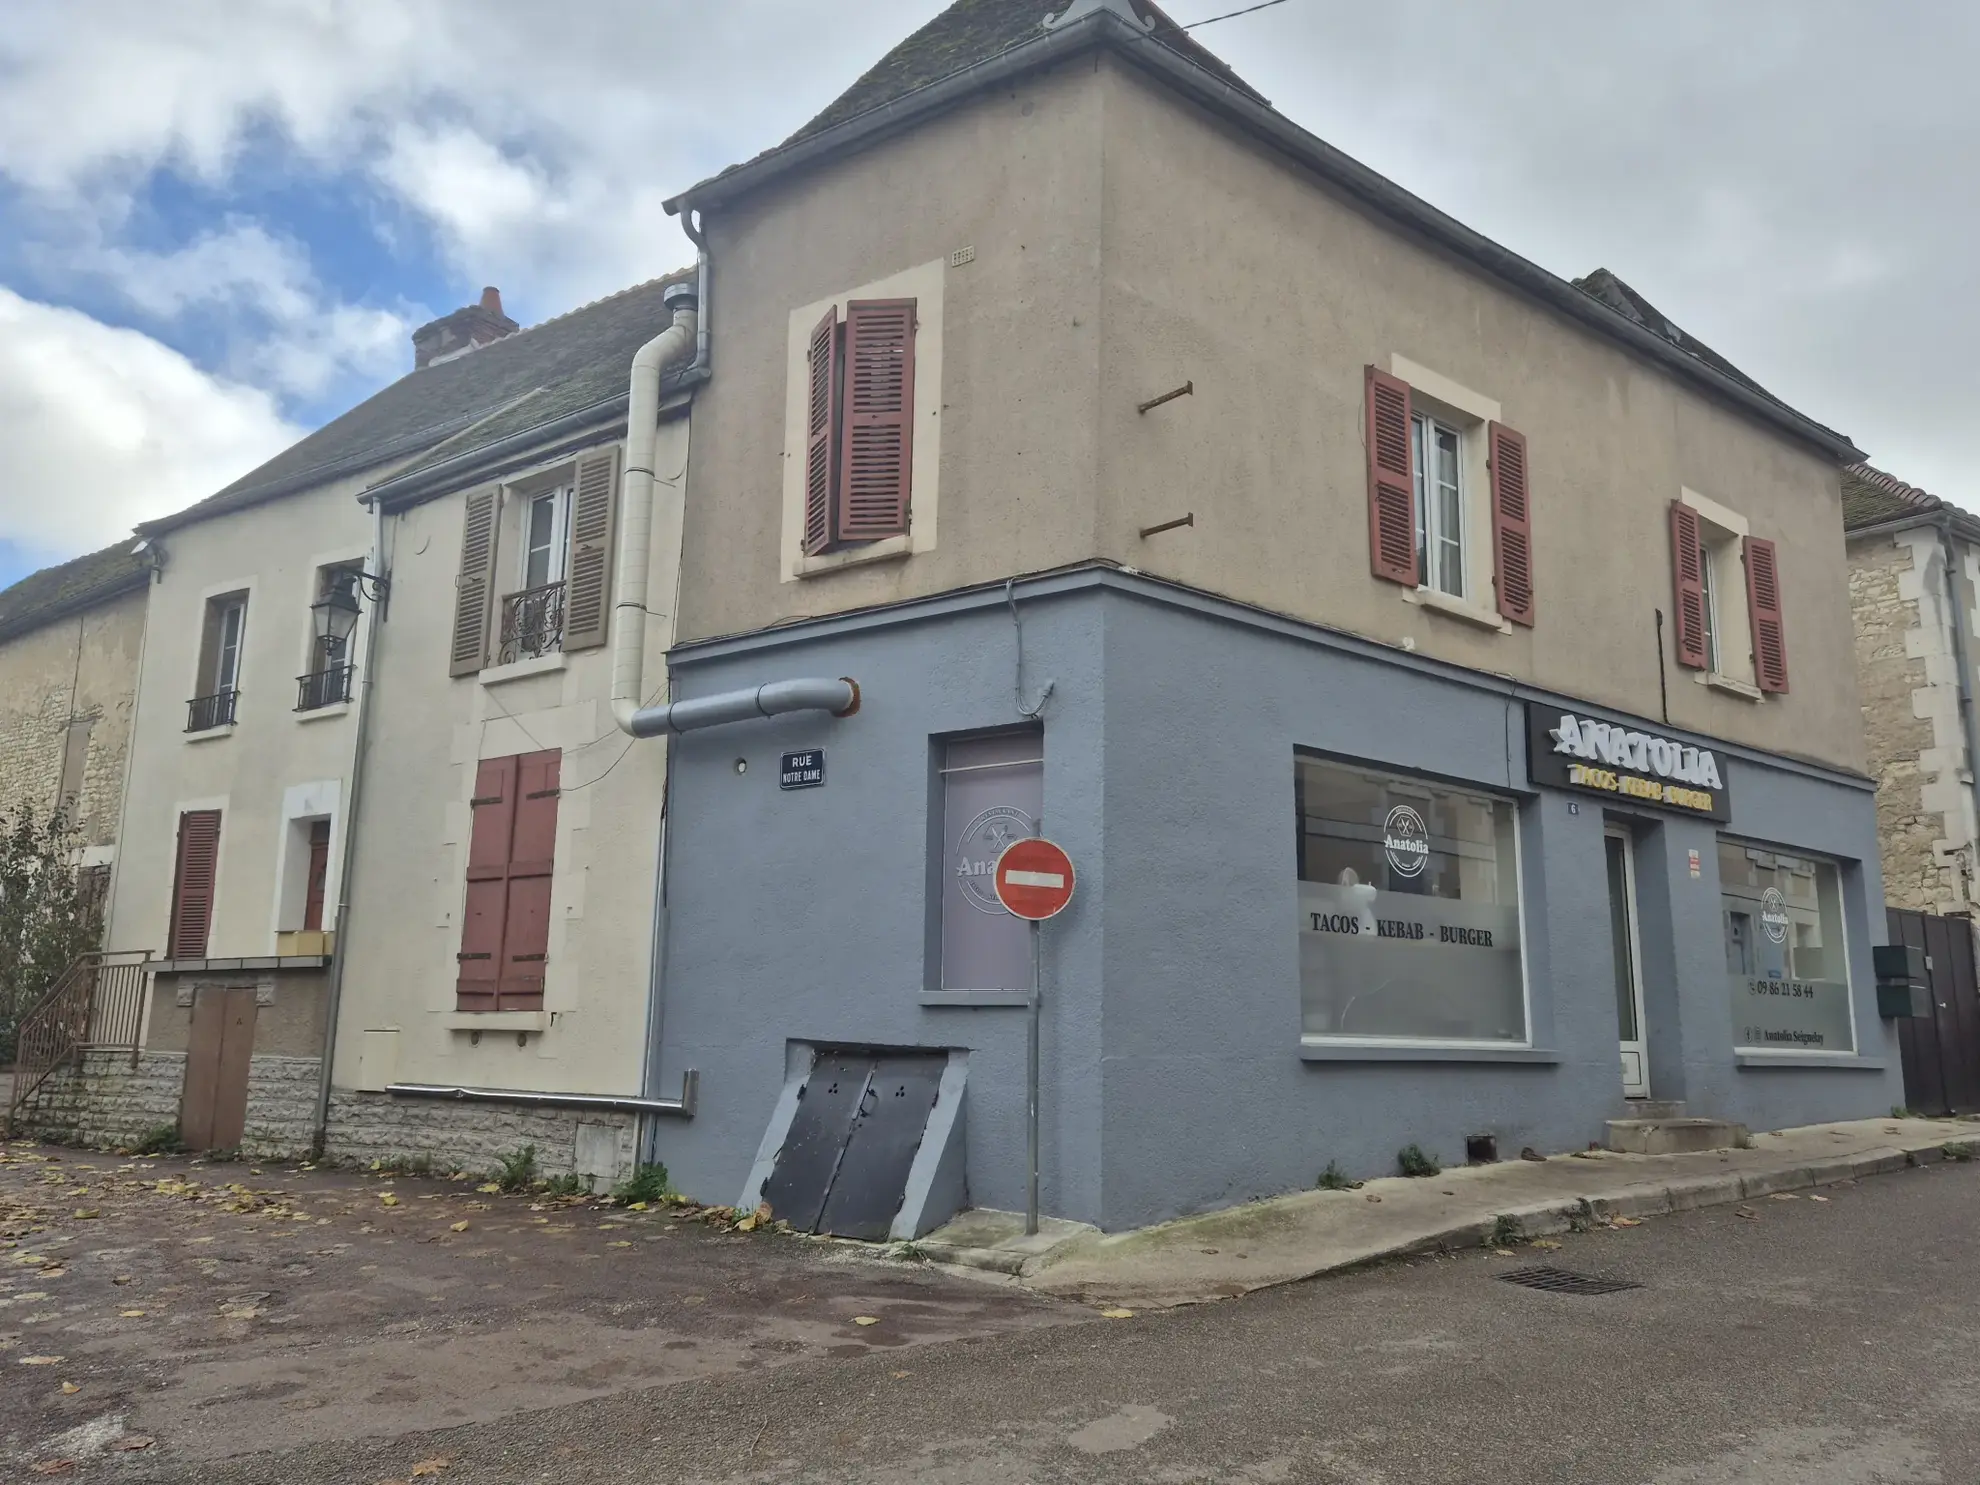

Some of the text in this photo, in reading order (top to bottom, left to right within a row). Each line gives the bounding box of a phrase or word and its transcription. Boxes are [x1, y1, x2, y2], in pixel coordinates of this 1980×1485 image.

[792, 755, 812, 767] RUE
[1549, 714, 1722, 790] ANATOLIA
[783, 770, 820, 783] NOTRE DAME
[1384, 834, 1429, 854] Anatolia
[1311, 912, 1359, 934] TACOS
[1377, 919, 1424, 940] KEBAB
[1440, 925, 1493, 947] BURGER
[1757, 981, 1767, 994] 09
[1769, 982, 1779, 995] 86
[1781, 982, 1790, 996] 21
[1804, 984, 1813, 998] 44
